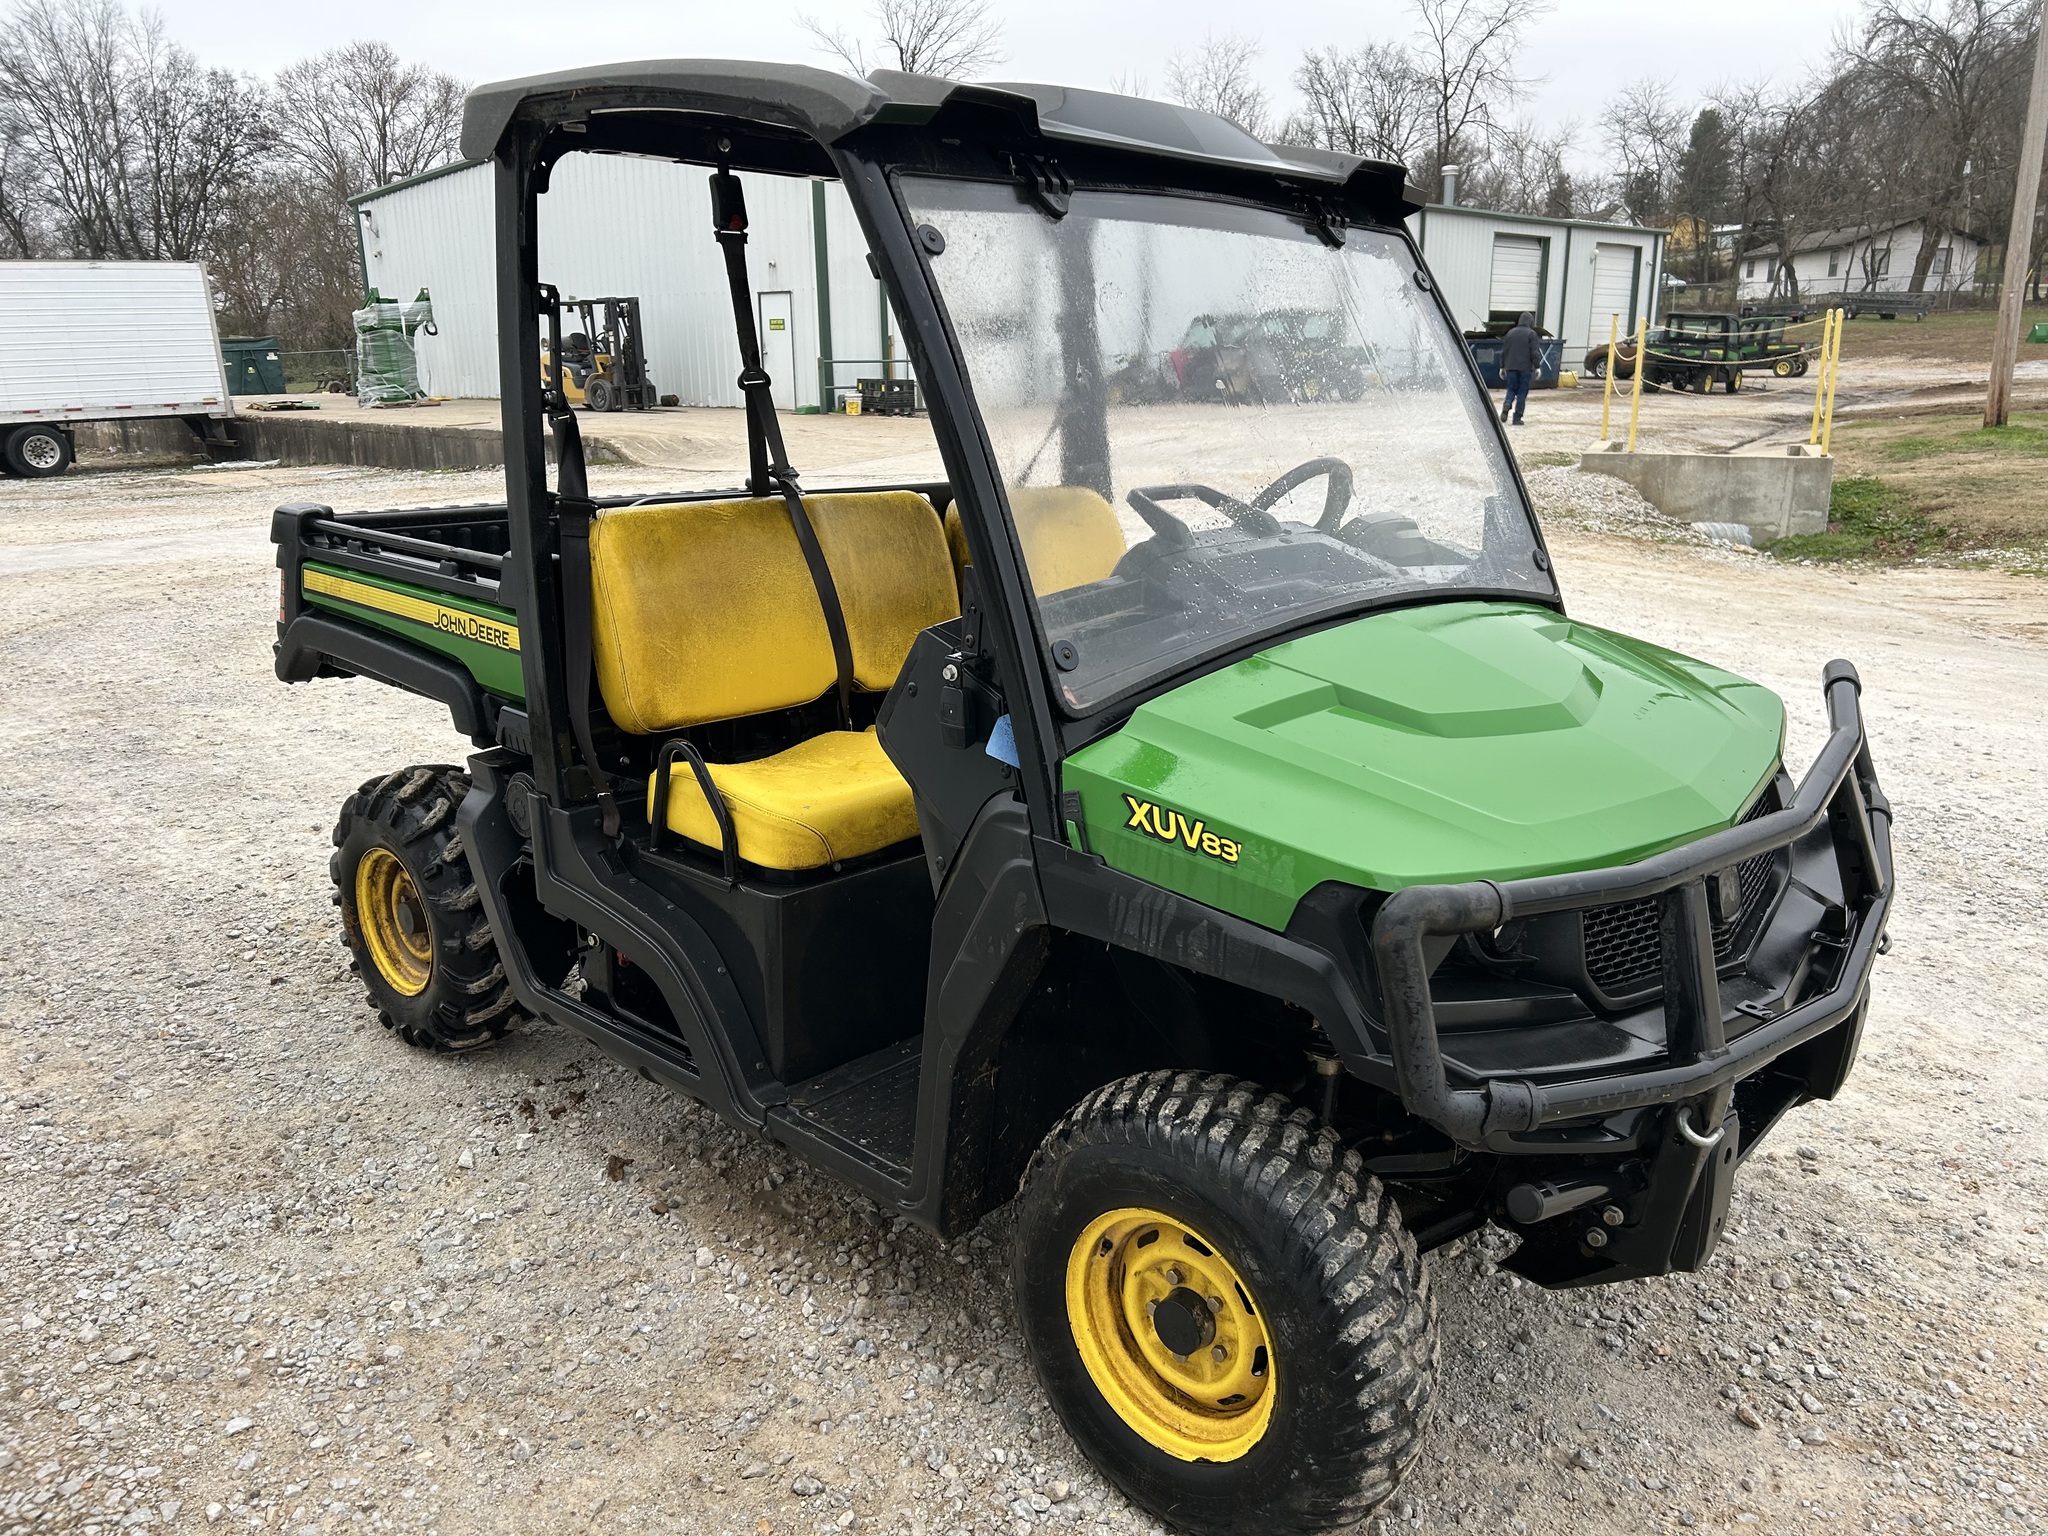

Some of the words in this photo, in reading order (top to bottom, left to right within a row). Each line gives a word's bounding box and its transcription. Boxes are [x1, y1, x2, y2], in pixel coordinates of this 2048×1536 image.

[433, 608, 466, 634] JOHN
[468, 617, 510, 647] DEERE
[1123, 794, 1242, 864] XUV83
